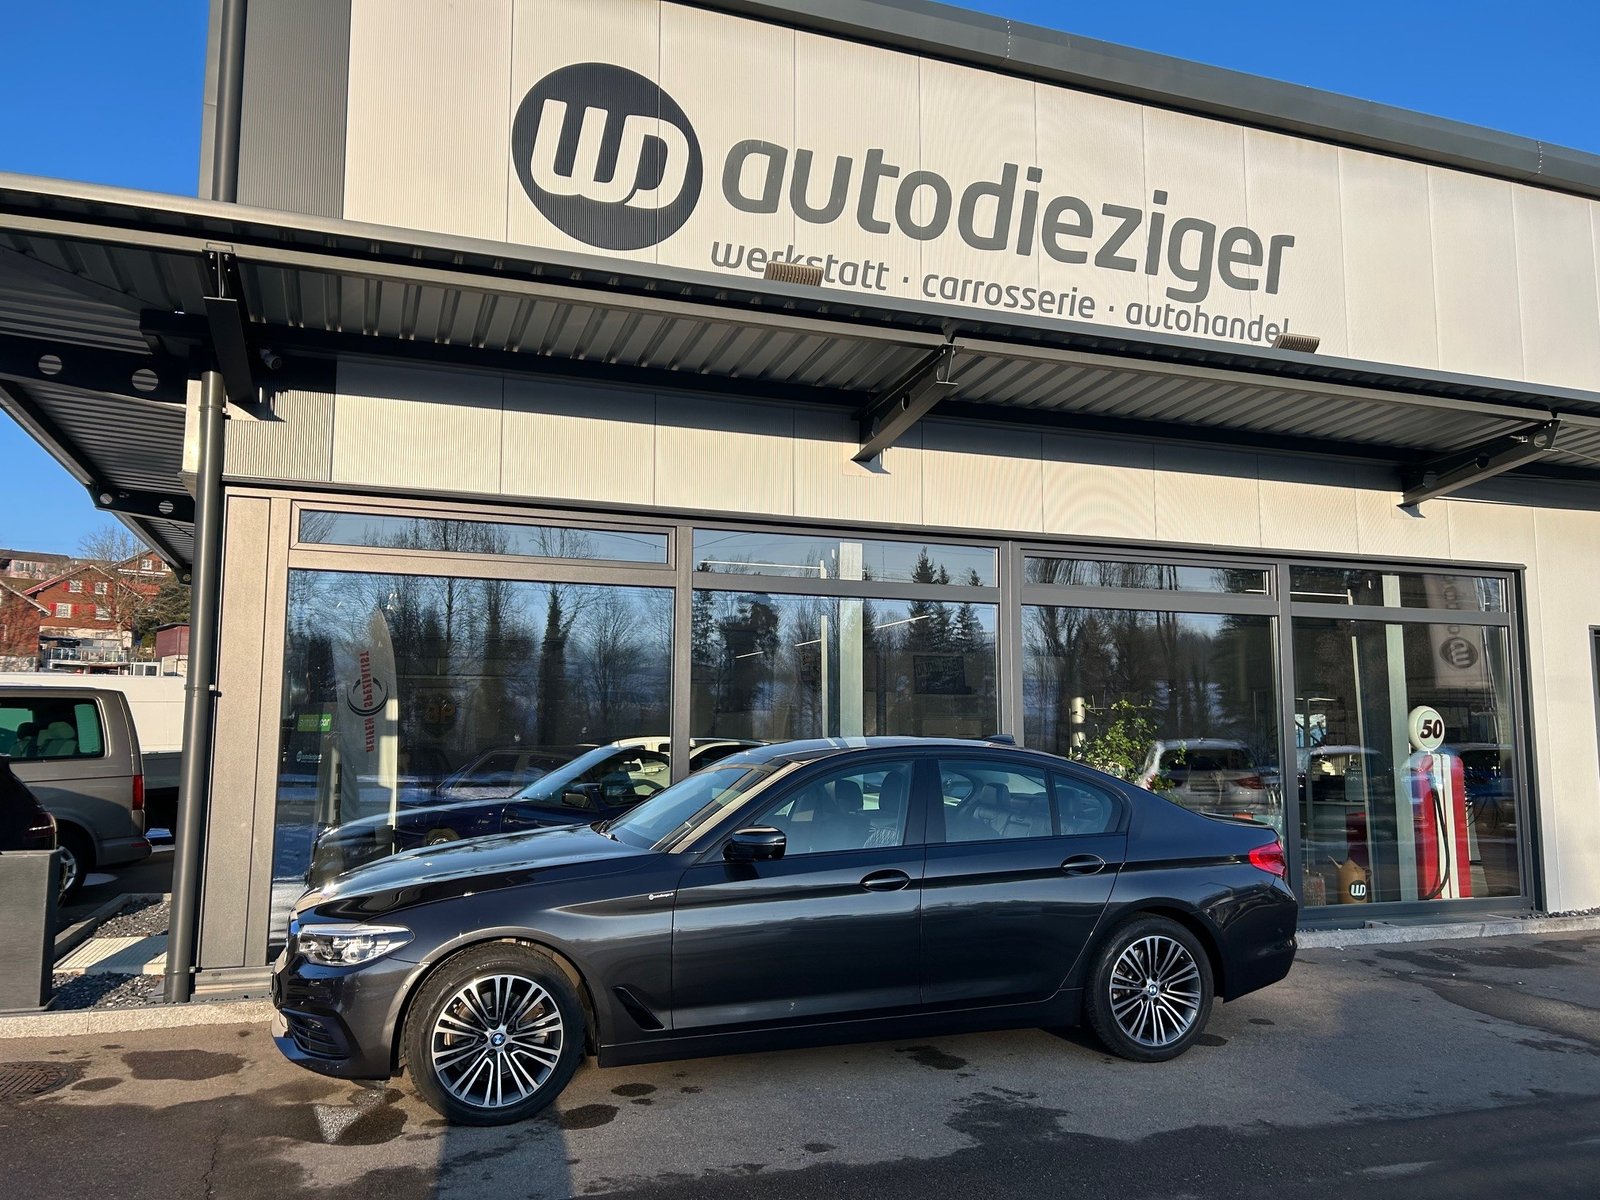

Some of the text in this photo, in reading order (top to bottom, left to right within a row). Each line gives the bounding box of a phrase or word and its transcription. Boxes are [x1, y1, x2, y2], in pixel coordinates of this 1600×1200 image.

[721, 138, 1295, 303] autodieziger
[922, 273, 1096, 319] carrosserie
[1420, 719, 1443, 739] 50
